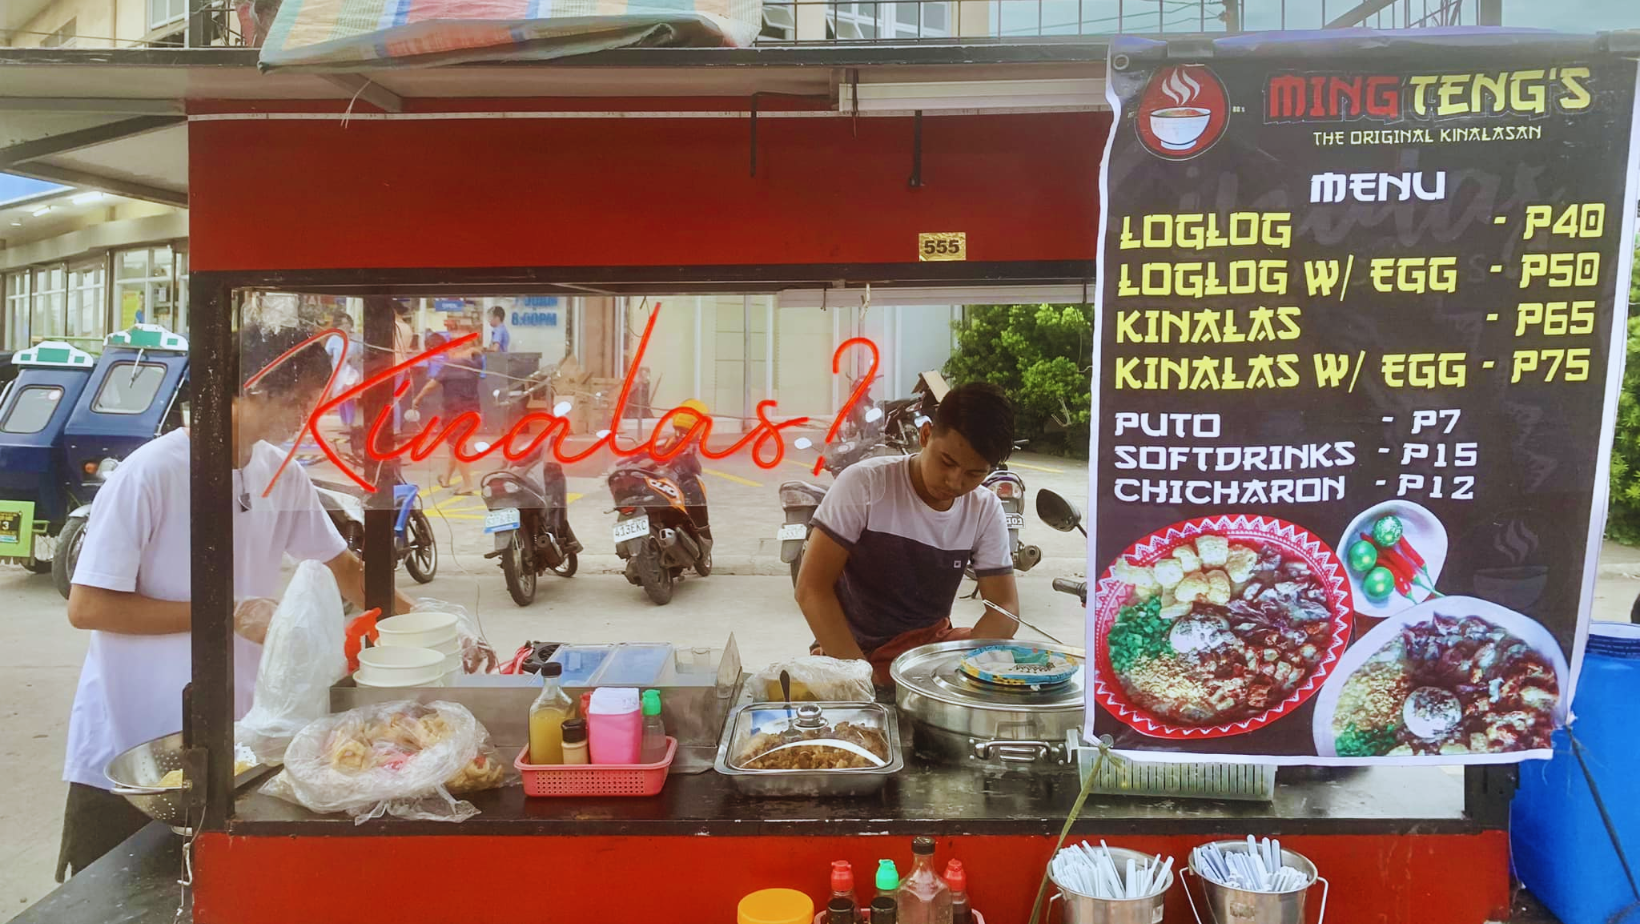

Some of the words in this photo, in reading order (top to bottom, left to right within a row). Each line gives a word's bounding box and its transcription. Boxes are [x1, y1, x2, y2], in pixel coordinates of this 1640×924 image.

[1271, 78, 1396, 116] MING
[1410, 68, 1590, 115] TENG'S
[1313, 132, 1344, 145] THE
[1351, 129, 1433, 144] ORIGINAL
[1441, 126, 1541, 142] KINALASAN
[1310, 172, 1445, 202] MENU
[1120, 212, 1291, 250] LOGLOG
[1524, 203, 1605, 239] P40
[924, 239, 960, 254] 555
[1118, 260, 1287, 298] LOGLOG
[1304, 255, 1354, 301] W/
[1370, 257, 1456, 293] EGG
[1520, 253, 1600, 288] P50
[1117, 306, 1301, 343] KINALAS
[1516, 301, 1595, 336] P65
[1116, 354, 1299, 390] KINALAS
[1314, 351, 1365, 392] W/
[1382, 353, 1466, 388] EGG
[1511, 349, 1590, 383] P75
[1115, 413, 1220, 437] PUTO
[1412, 409, 1460, 434] P7
[1115, 442, 1355, 471] SOFTDRINKS
[1401, 443, 1477, 467] P15
[1115, 476, 1345, 504] CHICHARON
[1397, 474, 1474, 498] P12
